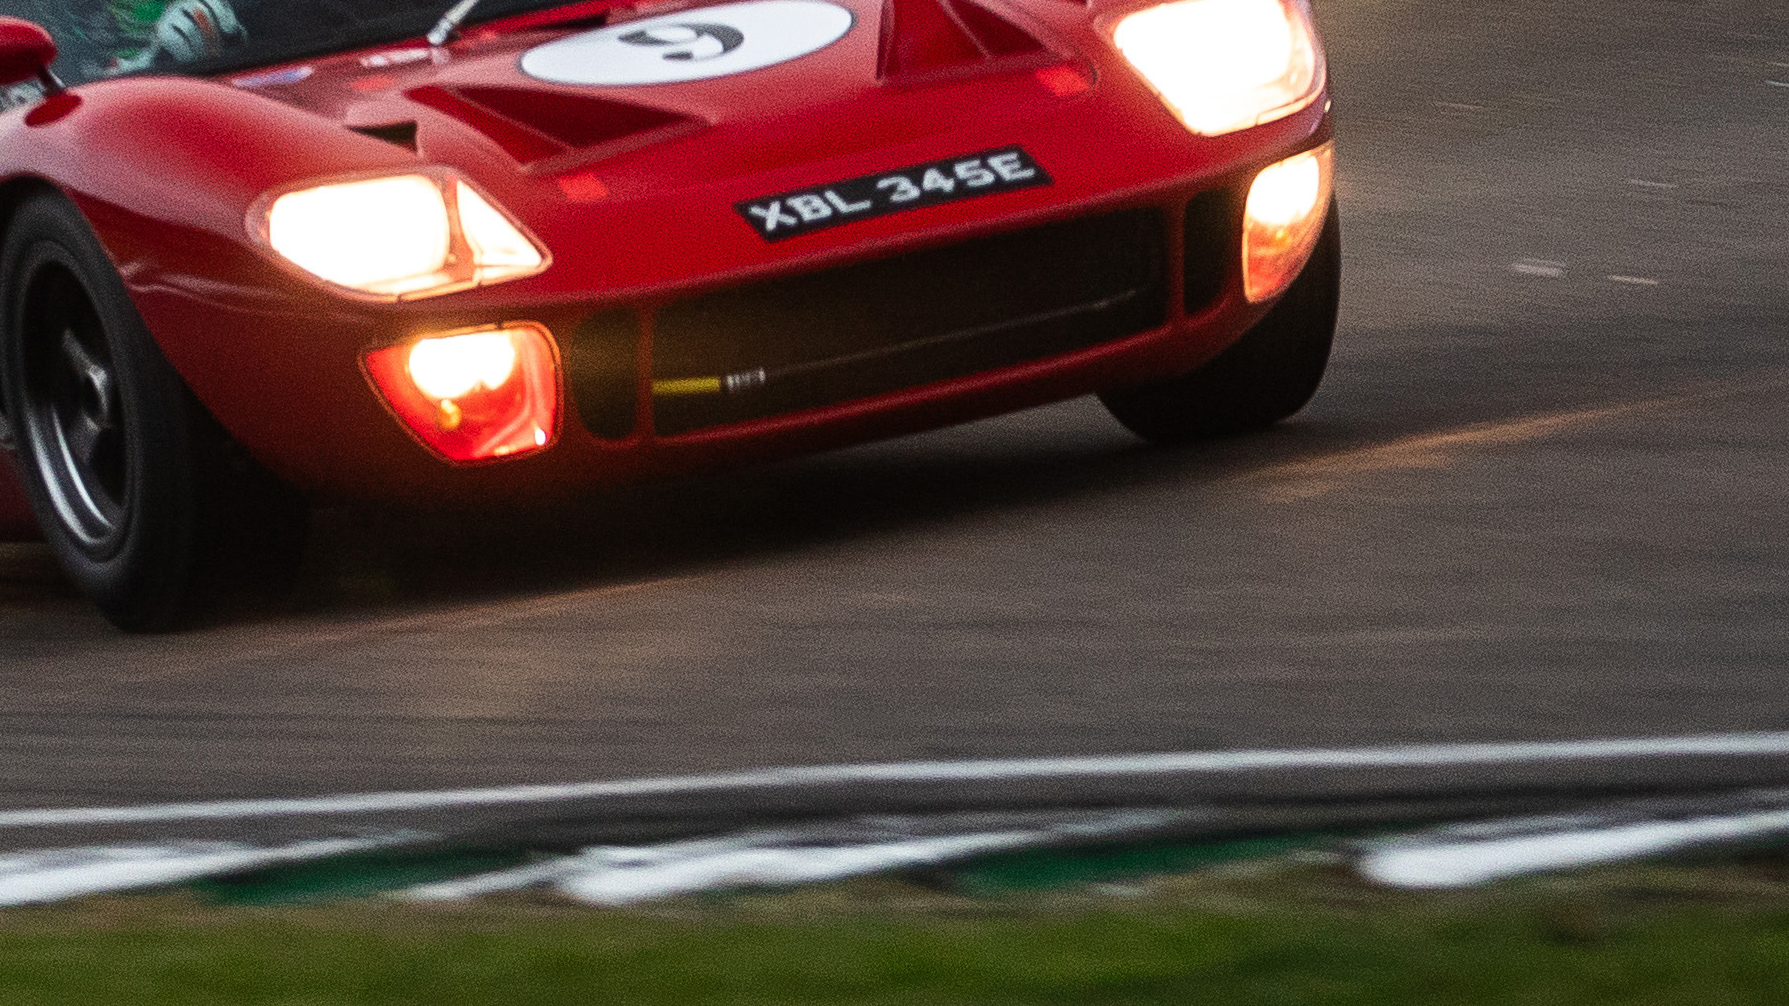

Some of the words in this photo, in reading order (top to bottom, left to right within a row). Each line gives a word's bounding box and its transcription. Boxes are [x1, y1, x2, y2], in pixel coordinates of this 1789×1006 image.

[617, 23, 745, 62] 9
[748, 190, 873, 232] XBL
[876, 151, 1036, 203] 345E
